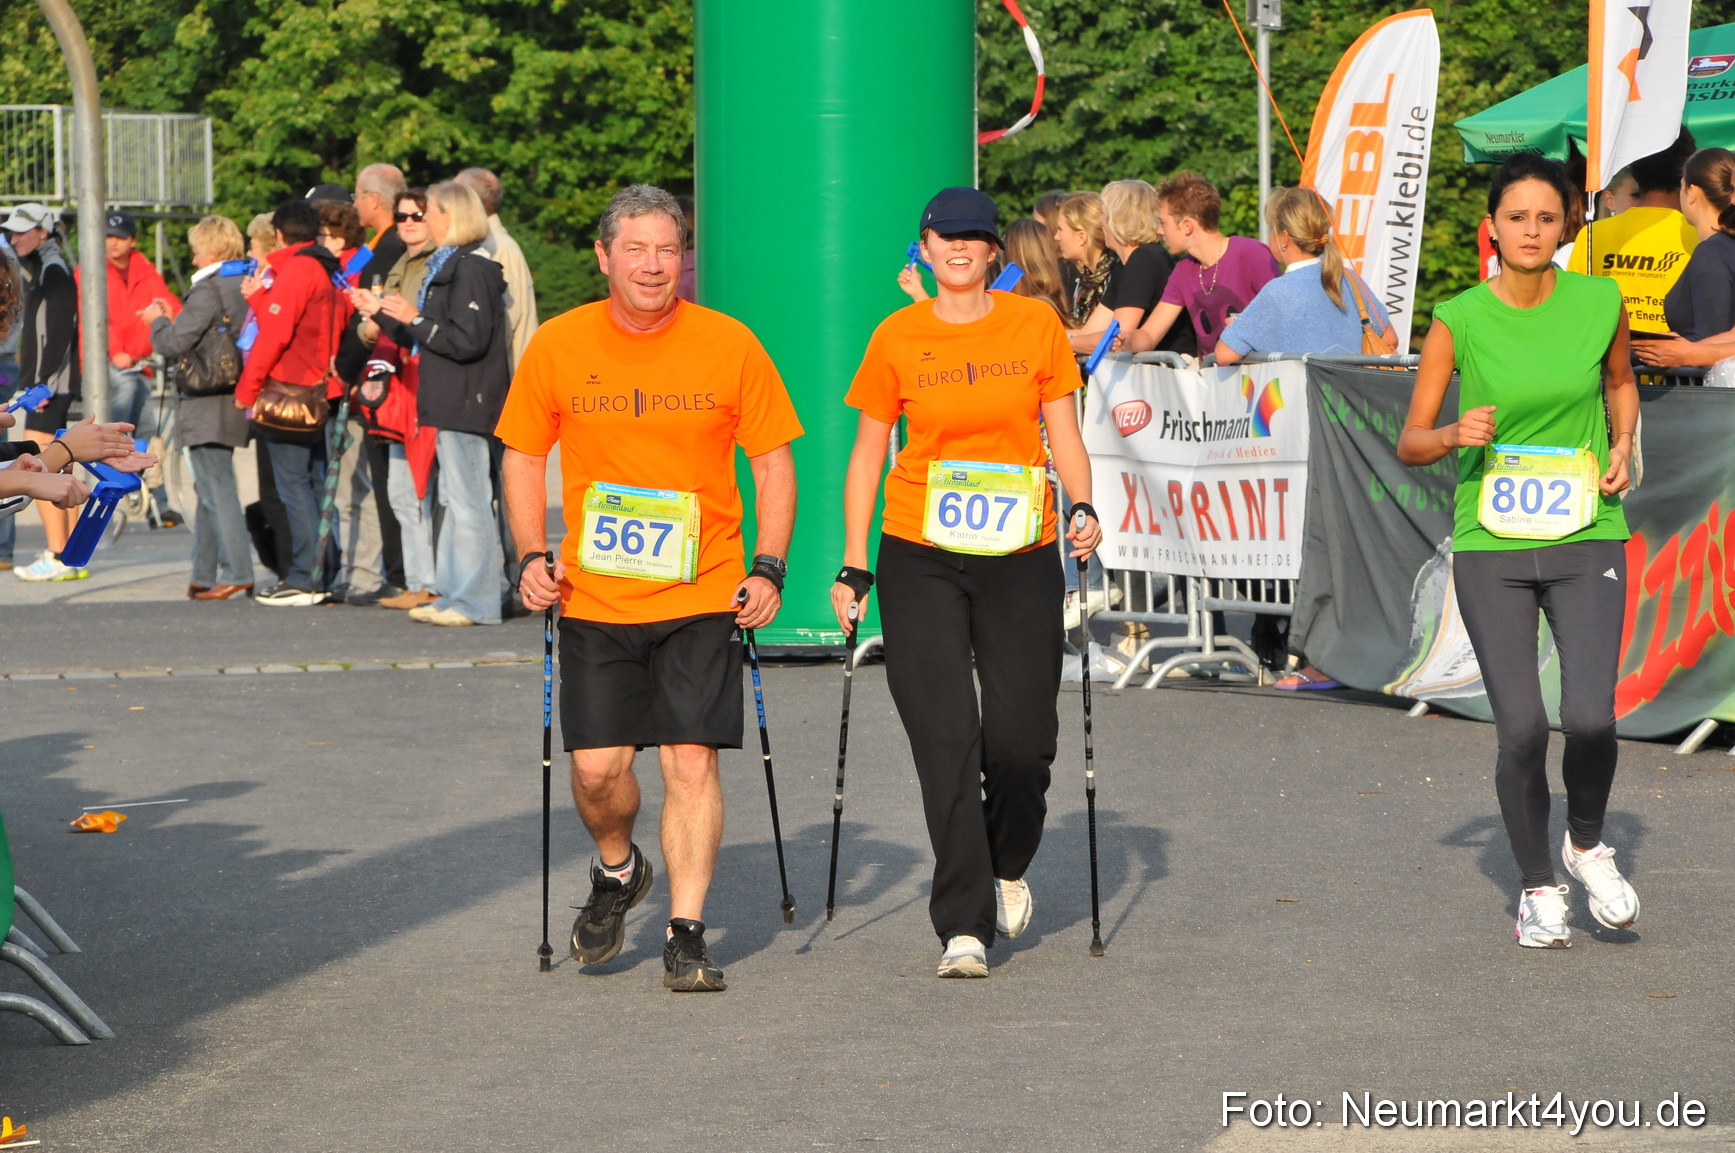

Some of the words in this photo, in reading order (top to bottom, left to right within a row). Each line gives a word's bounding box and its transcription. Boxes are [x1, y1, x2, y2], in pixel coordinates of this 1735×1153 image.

[1485, 131, 1525, 144] Neumarkter
[1329, 73, 1395, 277] EBL
[1385, 105, 1429, 316] www.klebl.de
[1602, 253, 1655, 271] swn
[1637, 272, 1667, 280] neumarkt
[1623, 295, 1665, 307] am-Tea
[1635, 310, 1667, 324] Energ
[917, 368, 964, 389] EURO
[980, 360, 1029, 379] POLES
[571, 395, 629, 414] EURO
[652, 393, 716, 411] POLES
[1115, 408, 1147, 429] NEU!
[1159, 410, 1250, 443] Frischmann
[1235, 446, 1276, 459] Medien
[943, 477, 981, 488] firmenlauf
[1492, 477, 1572, 516] 802
[597, 501, 636, 513] firmenlauf
[938, 491, 1018, 532] 607
[1118, 472, 1289, 542] XL-PRINT
[1499, 514, 1532, 525] Sabine
[593, 515, 674, 557] 567
[949, 530, 978, 541] Katrin
[589, 551, 612, 562] Jean
[615, 554, 643, 566] Pierre
